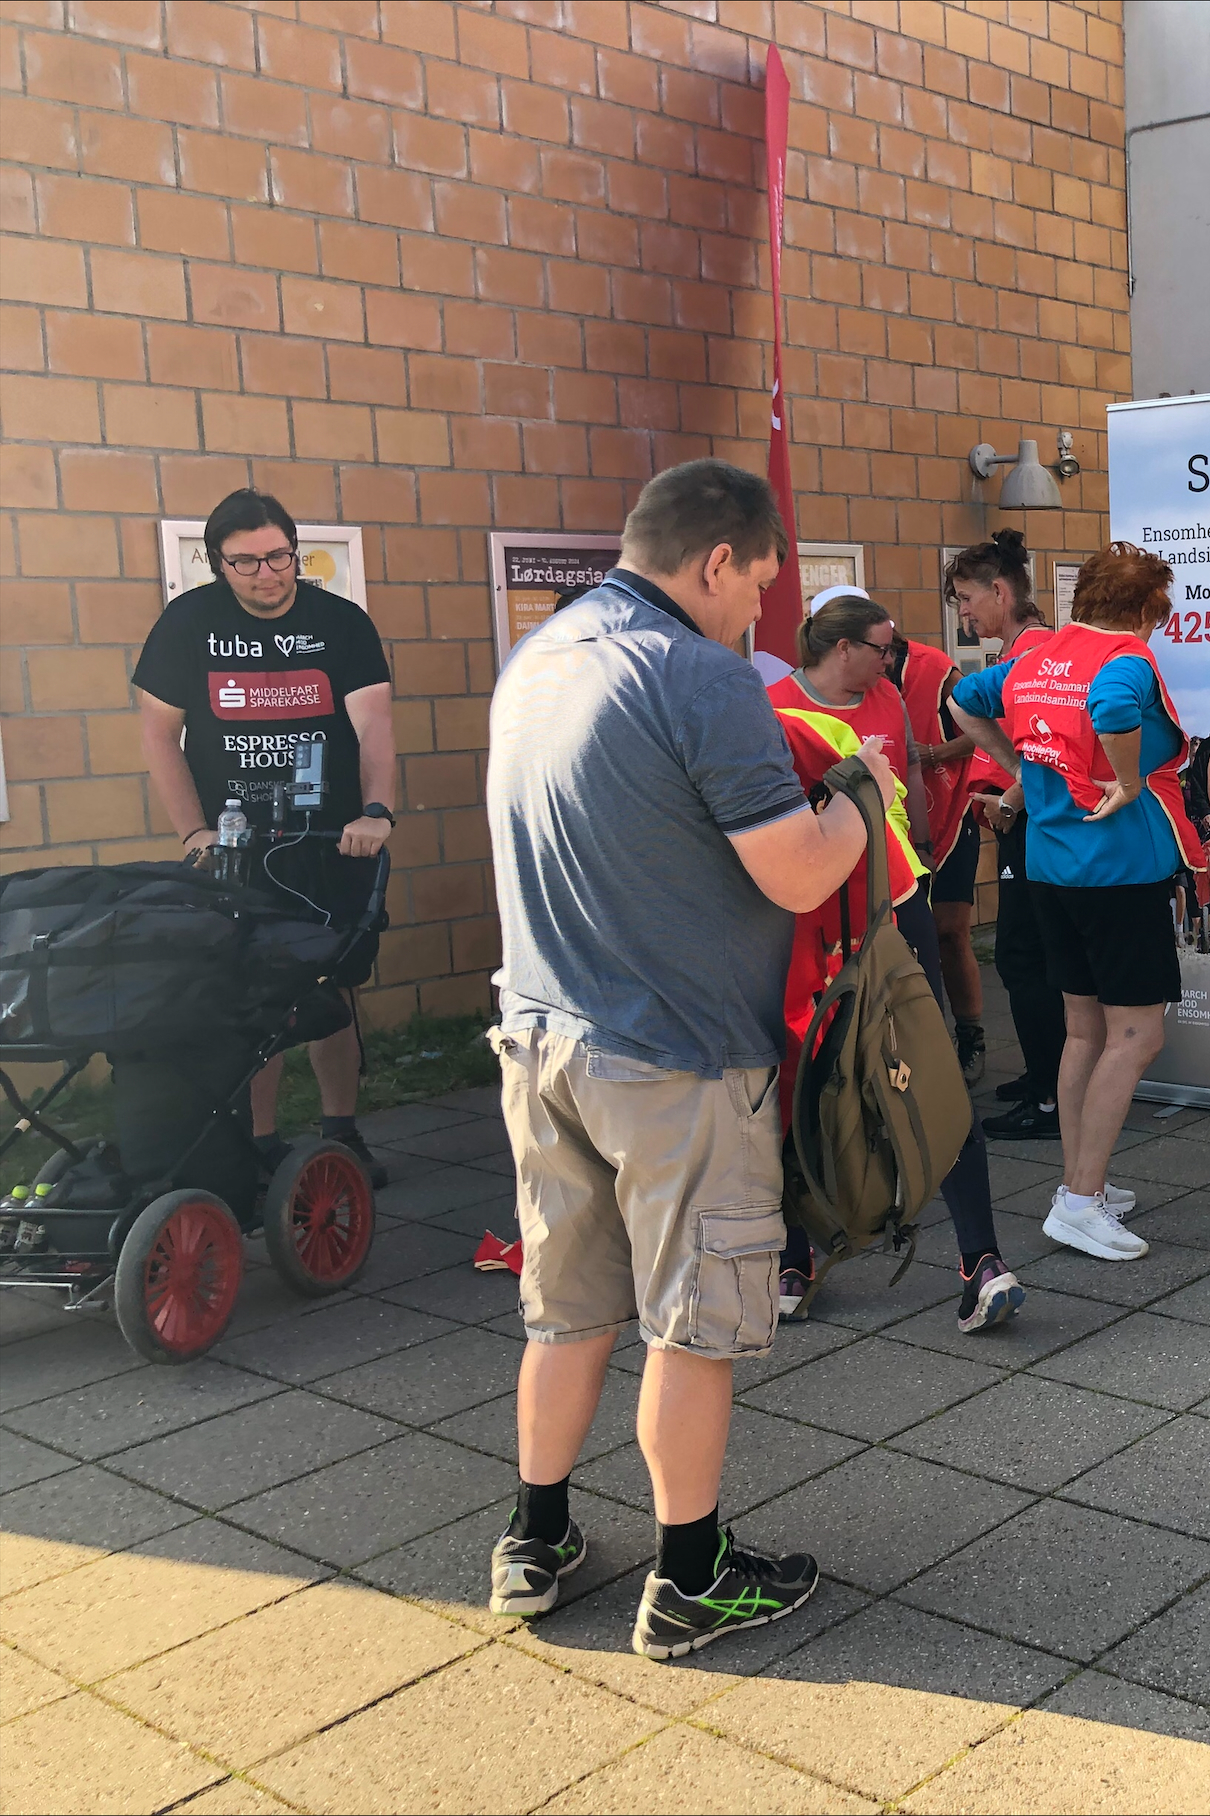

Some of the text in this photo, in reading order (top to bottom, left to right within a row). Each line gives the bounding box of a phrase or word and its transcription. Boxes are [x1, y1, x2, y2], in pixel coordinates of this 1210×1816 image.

[511, 564, 605, 587] Lørdagsja
[799, 564, 848, 586] ENGER
[207, 632, 263, 657] tuba
[1037, 658, 1073, 677] Støt
[250, 684, 319, 697] MIDDELFART
[1049, 679, 1090, 693] Danmar
[250, 694, 321, 707] SPAREKASSE
[1014, 692, 1087, 710] Landsindsamling
[223, 730, 327, 751] ESPRESSO
[240, 750, 294, 769] HOUS
[1022, 742, 1061, 759] MobilePay
[249, 781, 285, 791] DANS
[1177, 999, 1198, 1009] MOD
